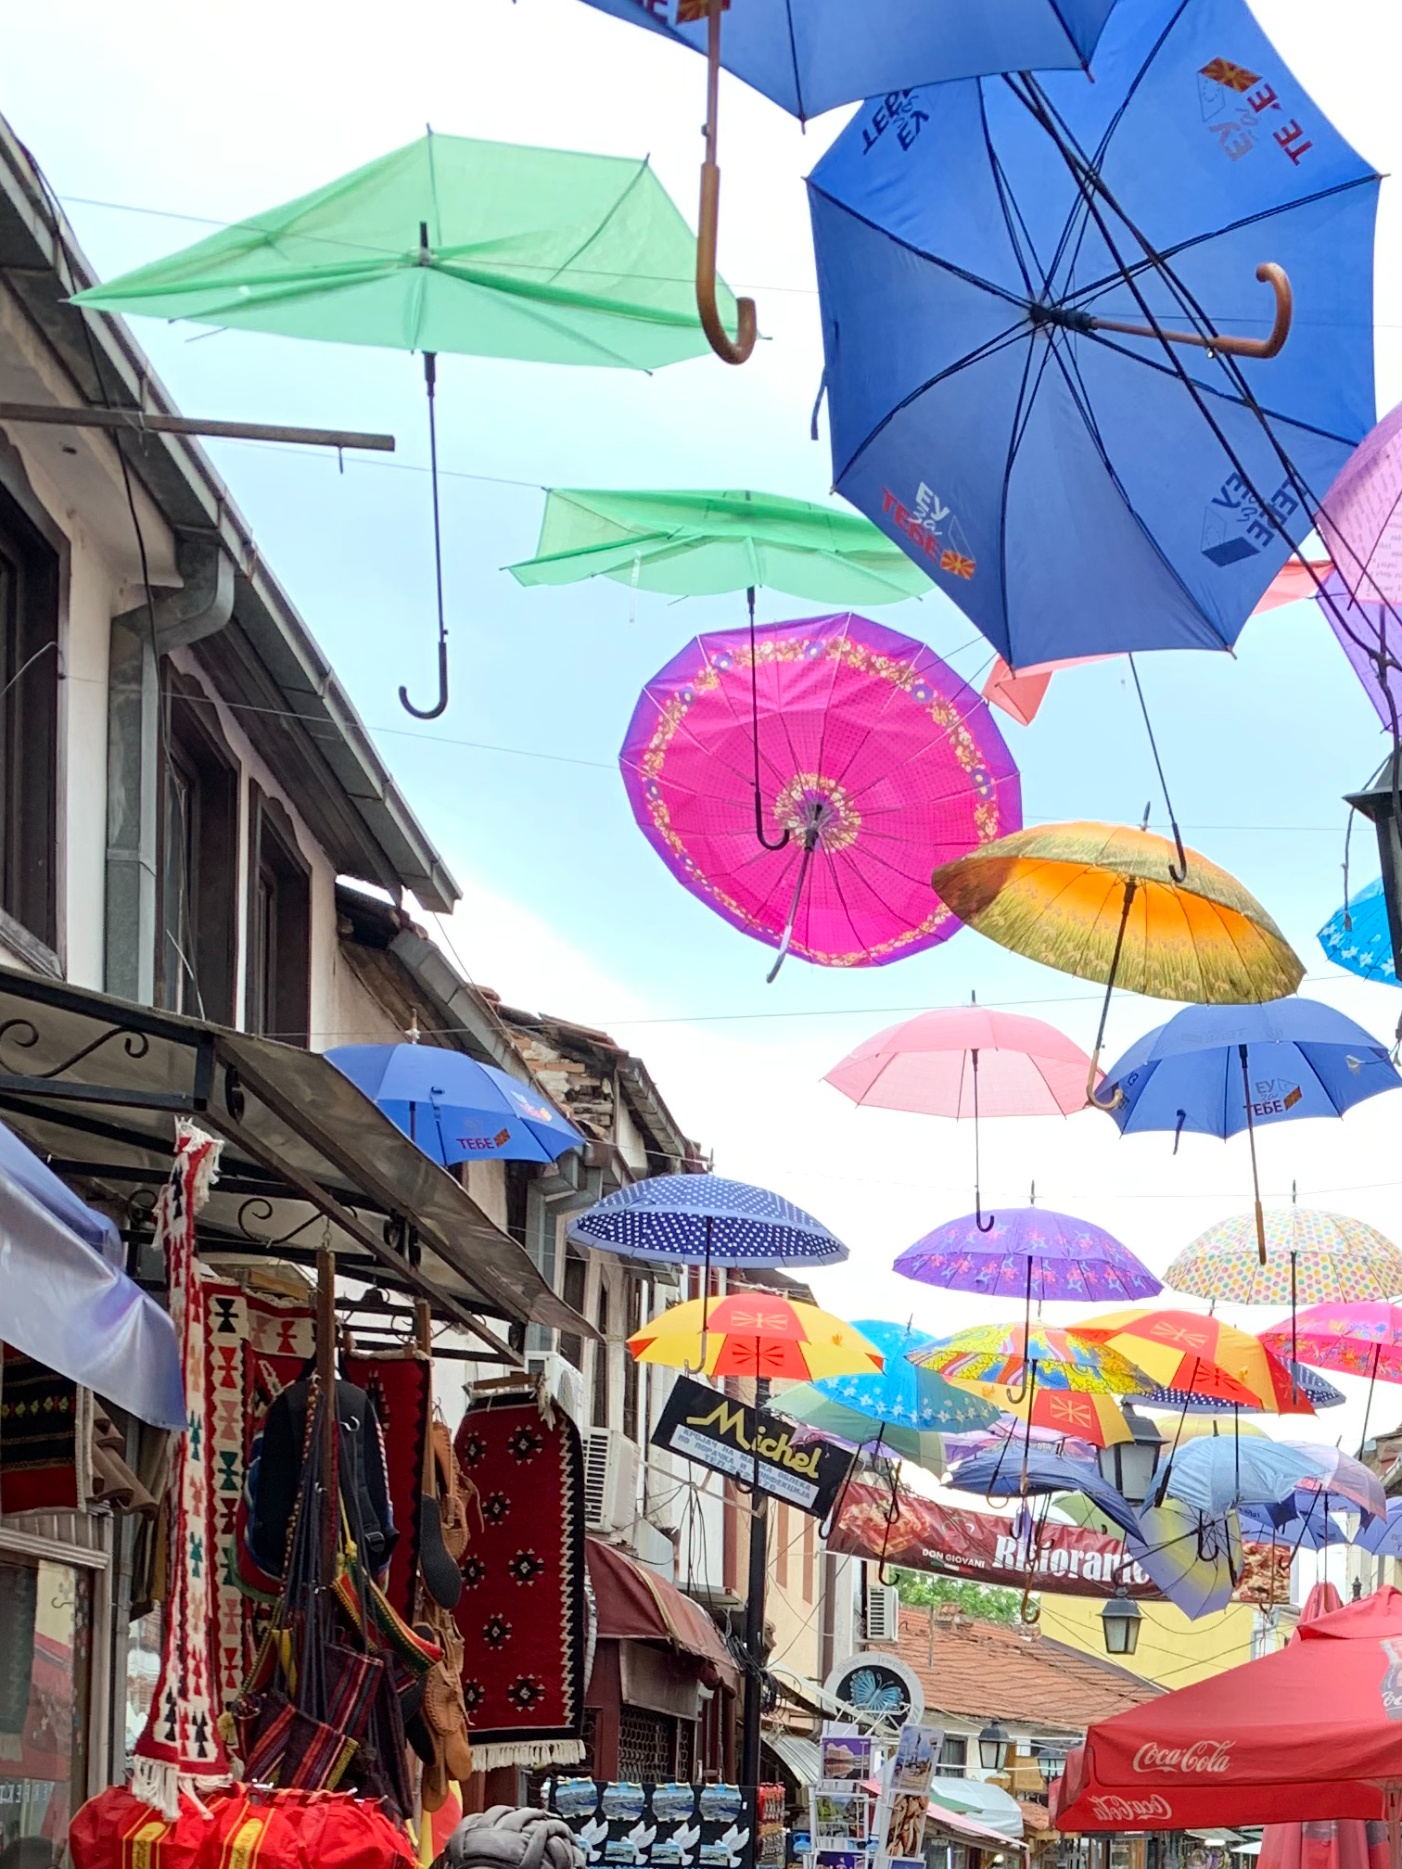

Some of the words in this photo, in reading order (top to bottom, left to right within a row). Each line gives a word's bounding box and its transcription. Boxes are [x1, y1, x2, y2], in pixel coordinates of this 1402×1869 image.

[686, 1400, 820, 1480] Michel
[752, 1468, 811, 1499] ОНФЕКЦИЈА
[922, 1548, 942, 1560] DON
[945, 1552, 986, 1570] GIOVANI
[1132, 1740, 1236, 1773] Coca-Cola
